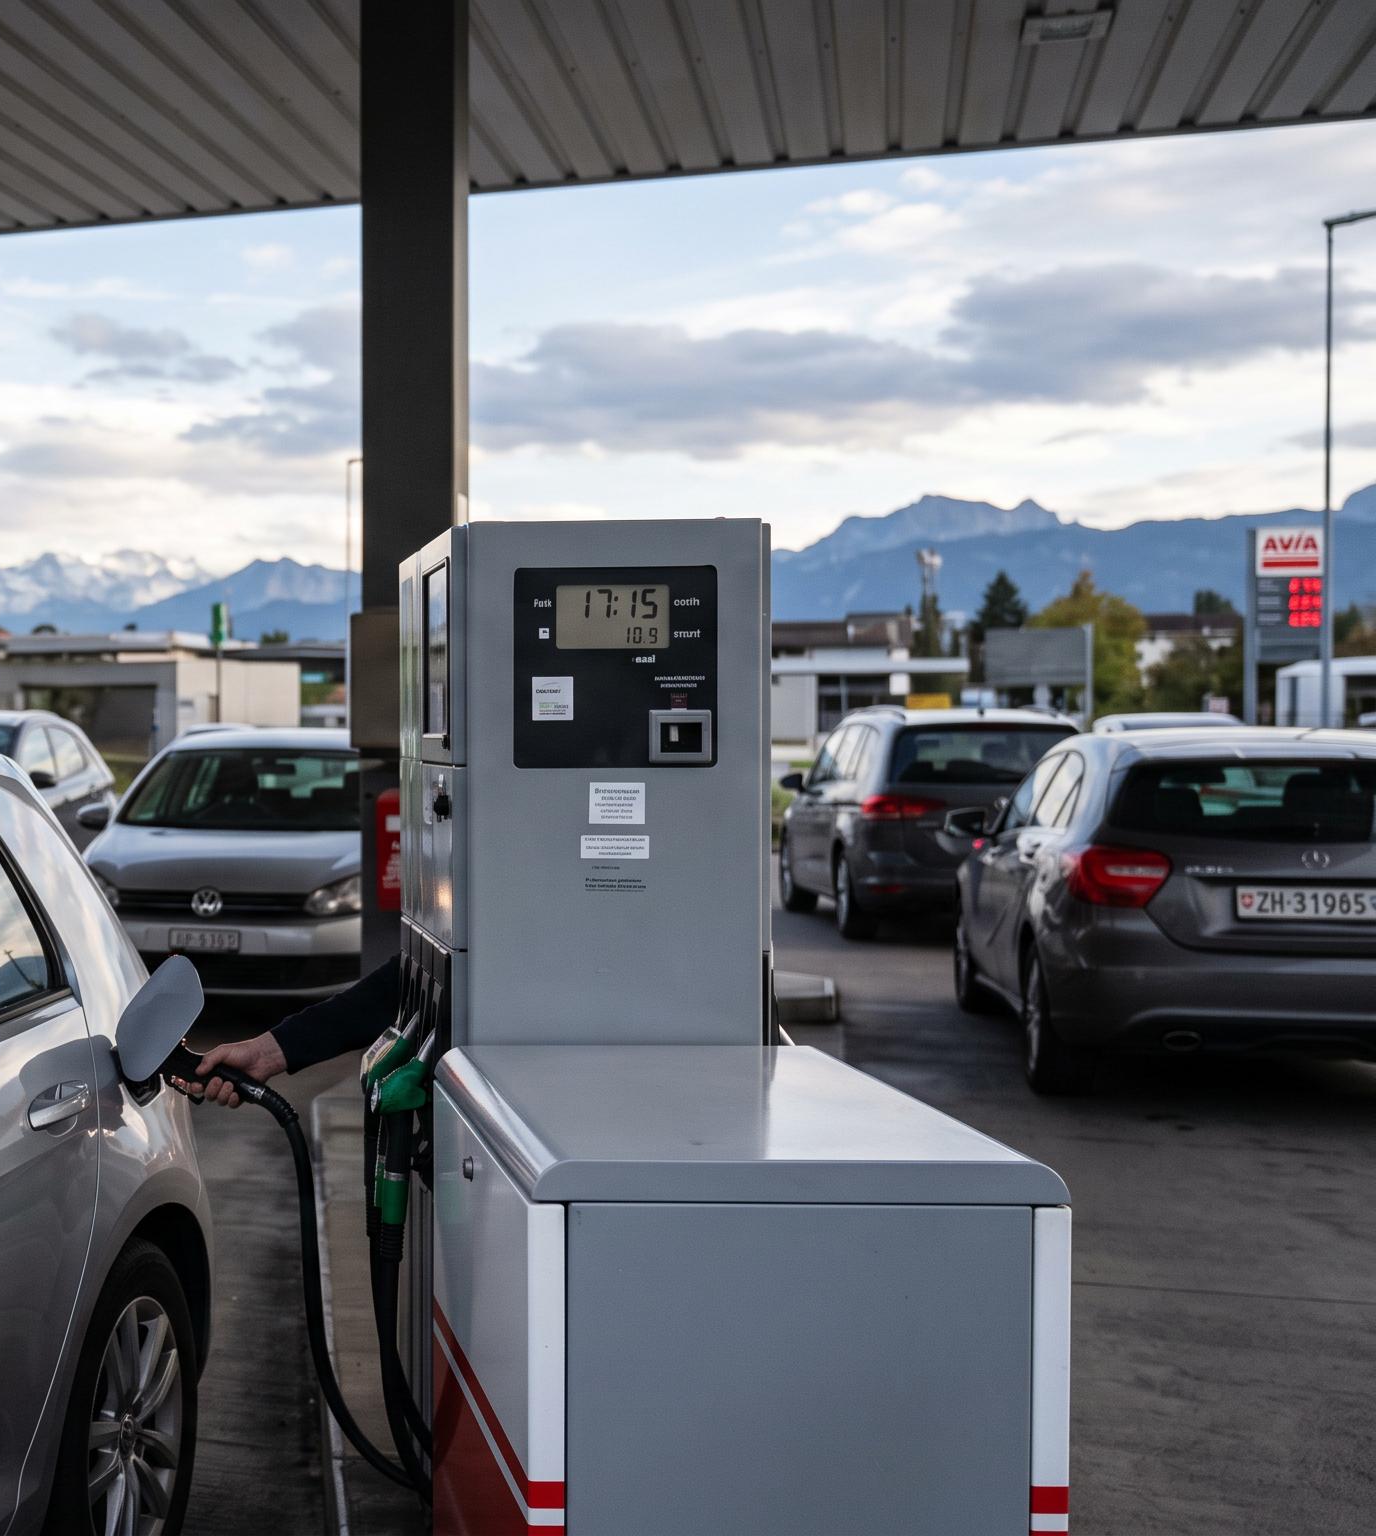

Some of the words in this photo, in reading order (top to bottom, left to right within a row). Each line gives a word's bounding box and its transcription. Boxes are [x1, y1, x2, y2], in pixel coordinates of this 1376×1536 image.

[1264, 532, 1318, 552] AVIA
[584, 588, 658, 619] 17:15
[626, 626, 658, 645] 10.9
